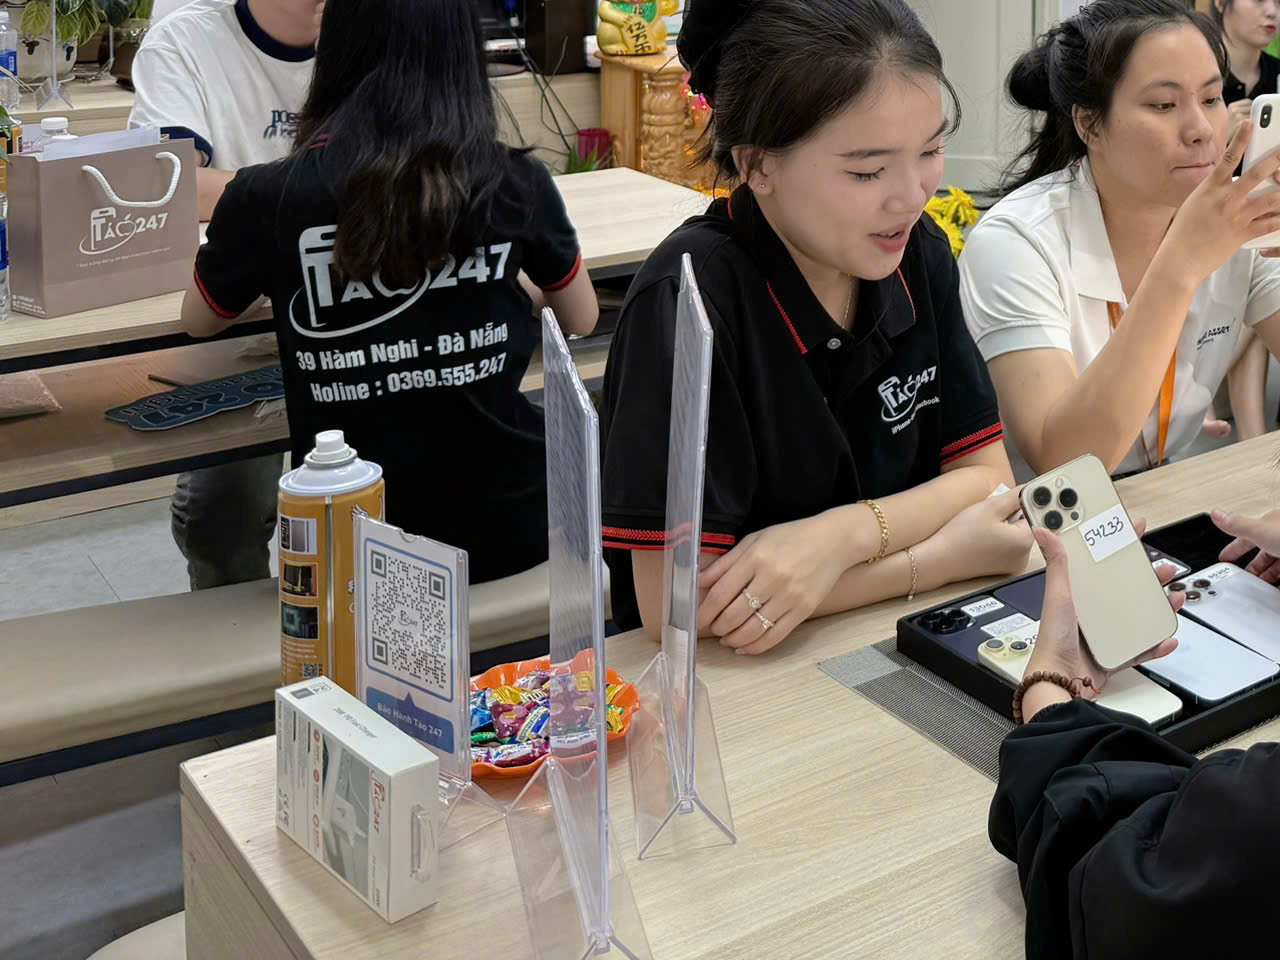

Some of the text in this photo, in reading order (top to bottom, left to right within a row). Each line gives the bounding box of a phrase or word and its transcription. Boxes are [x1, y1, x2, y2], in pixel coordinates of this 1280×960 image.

[296, 351, 316, 371] 39
[320, 347, 366, 371] Hàm
[370, 339, 419, 365] Nghi
[438, 332, 465, 356] Đà
[470, 322, 509, 350] Nẵng
[310, 382, 370, 403] Holine
[387, 352, 508, 393] 0369.555.247
[1083, 516, 1125, 547] 54233
